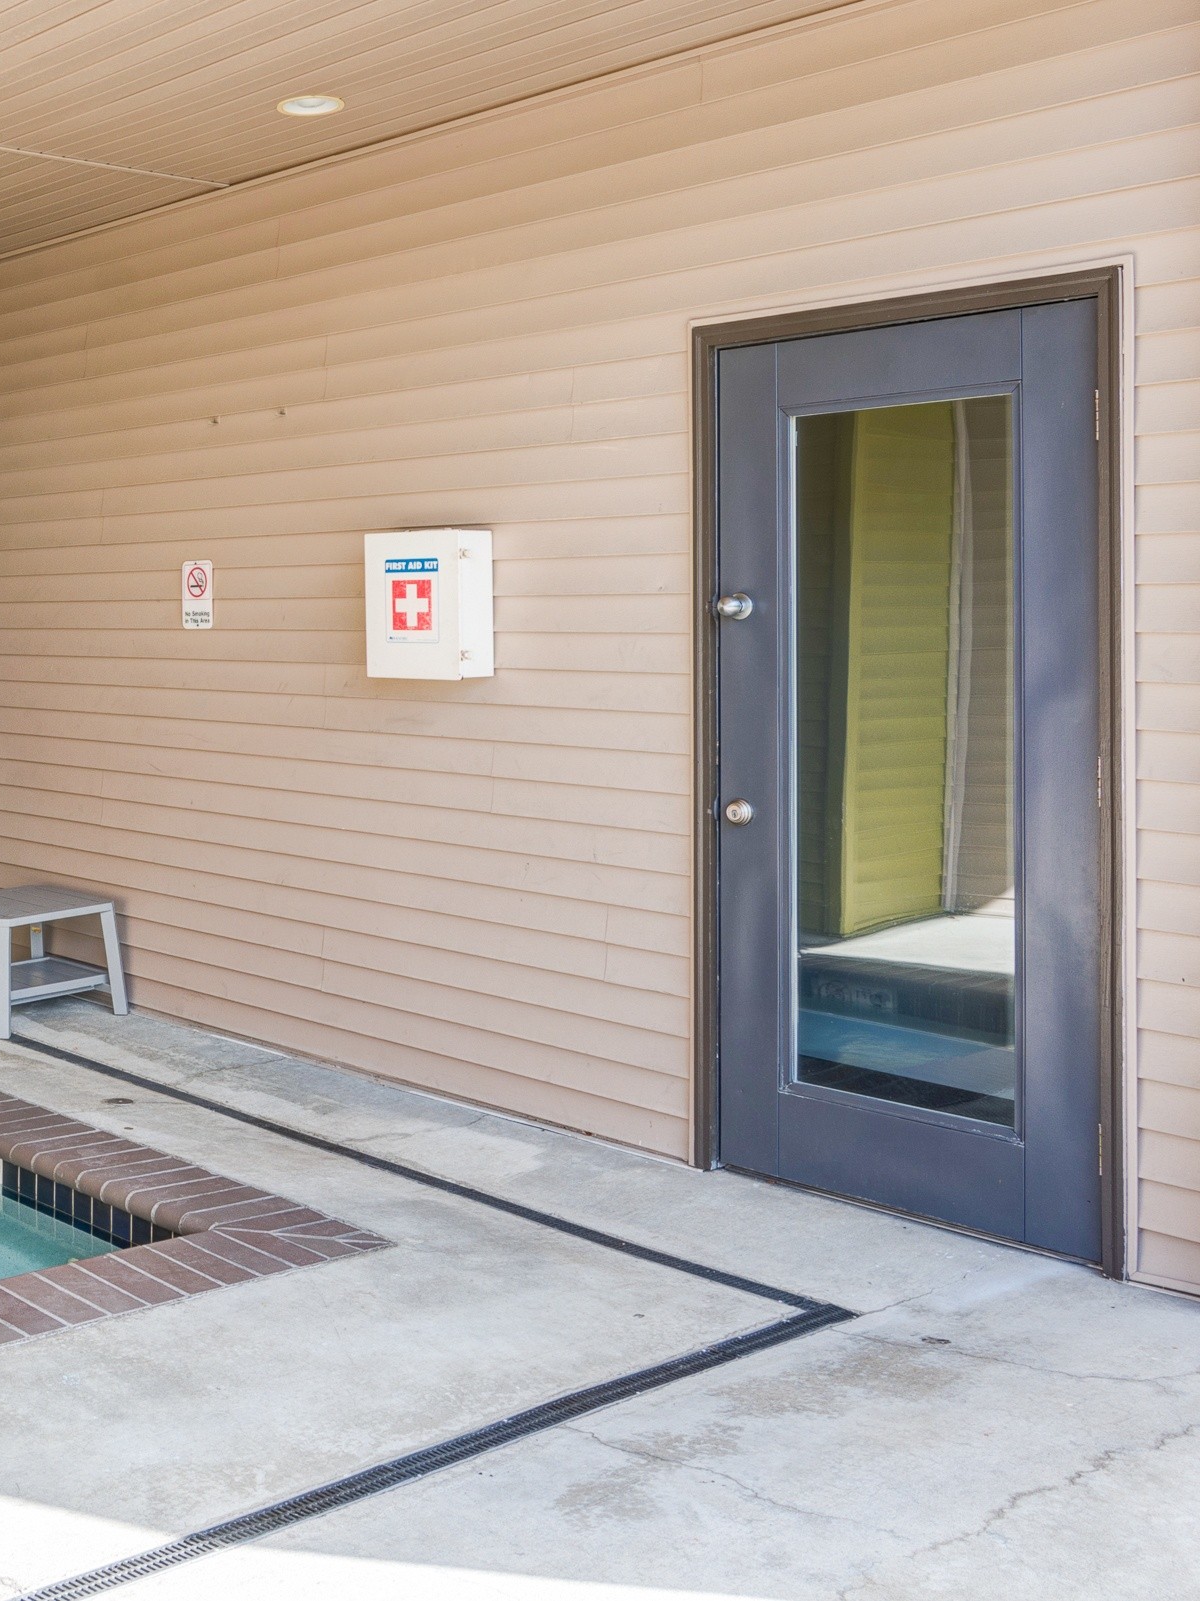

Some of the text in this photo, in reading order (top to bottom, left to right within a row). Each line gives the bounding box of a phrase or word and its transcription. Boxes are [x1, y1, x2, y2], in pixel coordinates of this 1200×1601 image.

[385, 560, 438, 571] FIRST AID KIT
